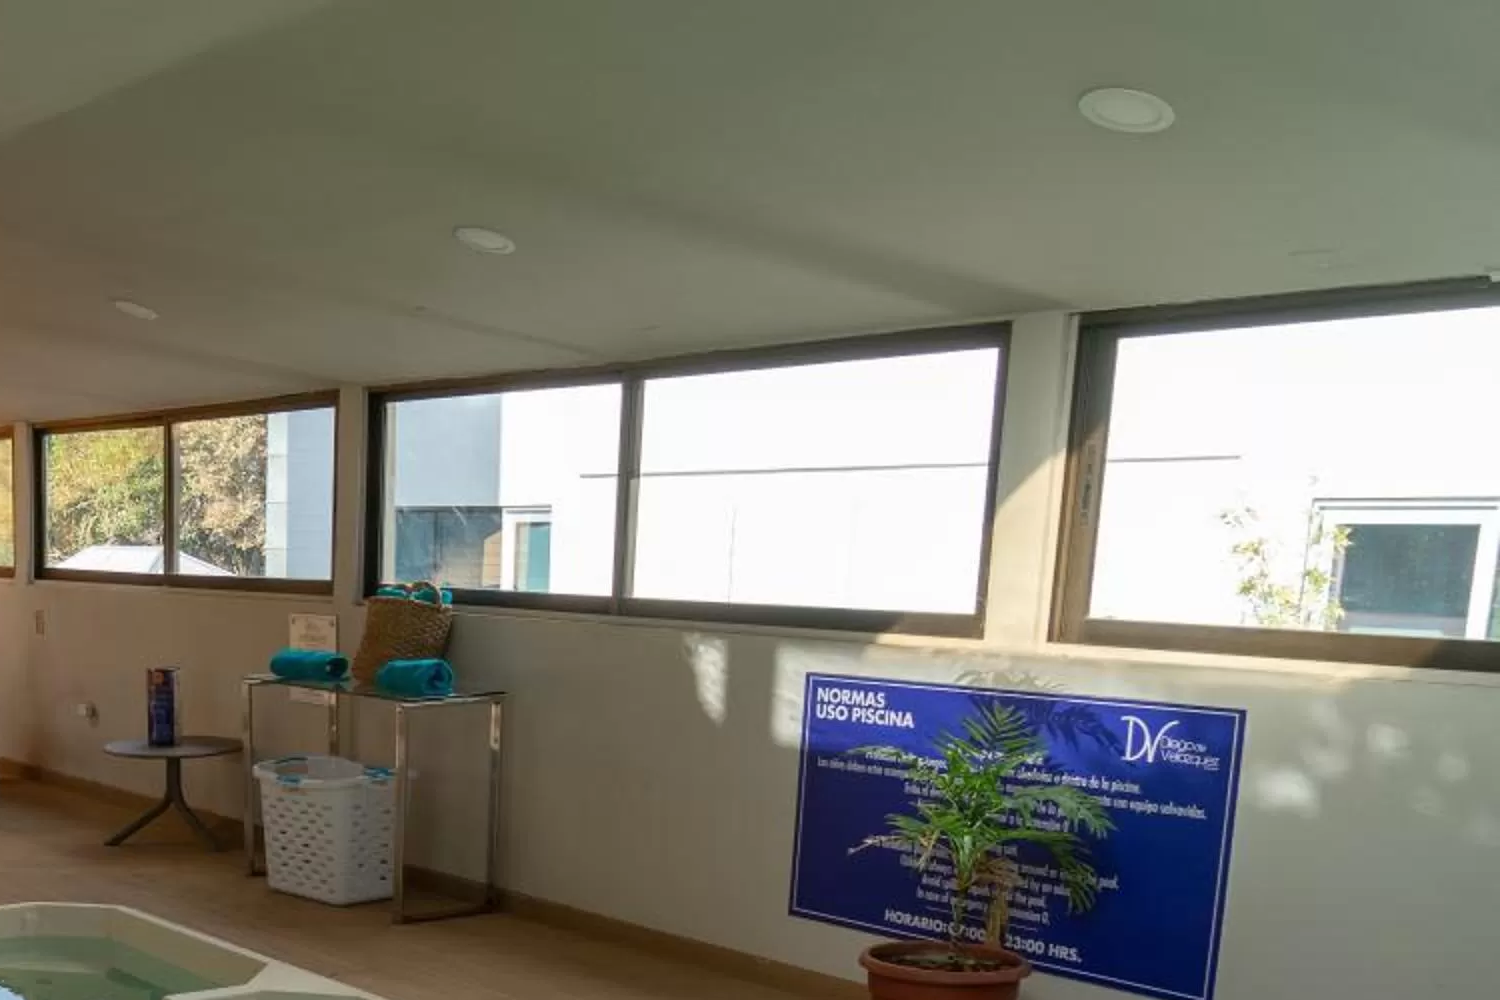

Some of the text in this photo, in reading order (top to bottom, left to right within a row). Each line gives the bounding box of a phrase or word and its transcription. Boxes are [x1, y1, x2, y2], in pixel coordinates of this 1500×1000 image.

[816, 687, 885, 708] NORMAS
[816, 703, 915, 729] USO PISCINA
[1120, 715, 1180, 763] DV
[1048, 942, 1082, 963] HRS.
